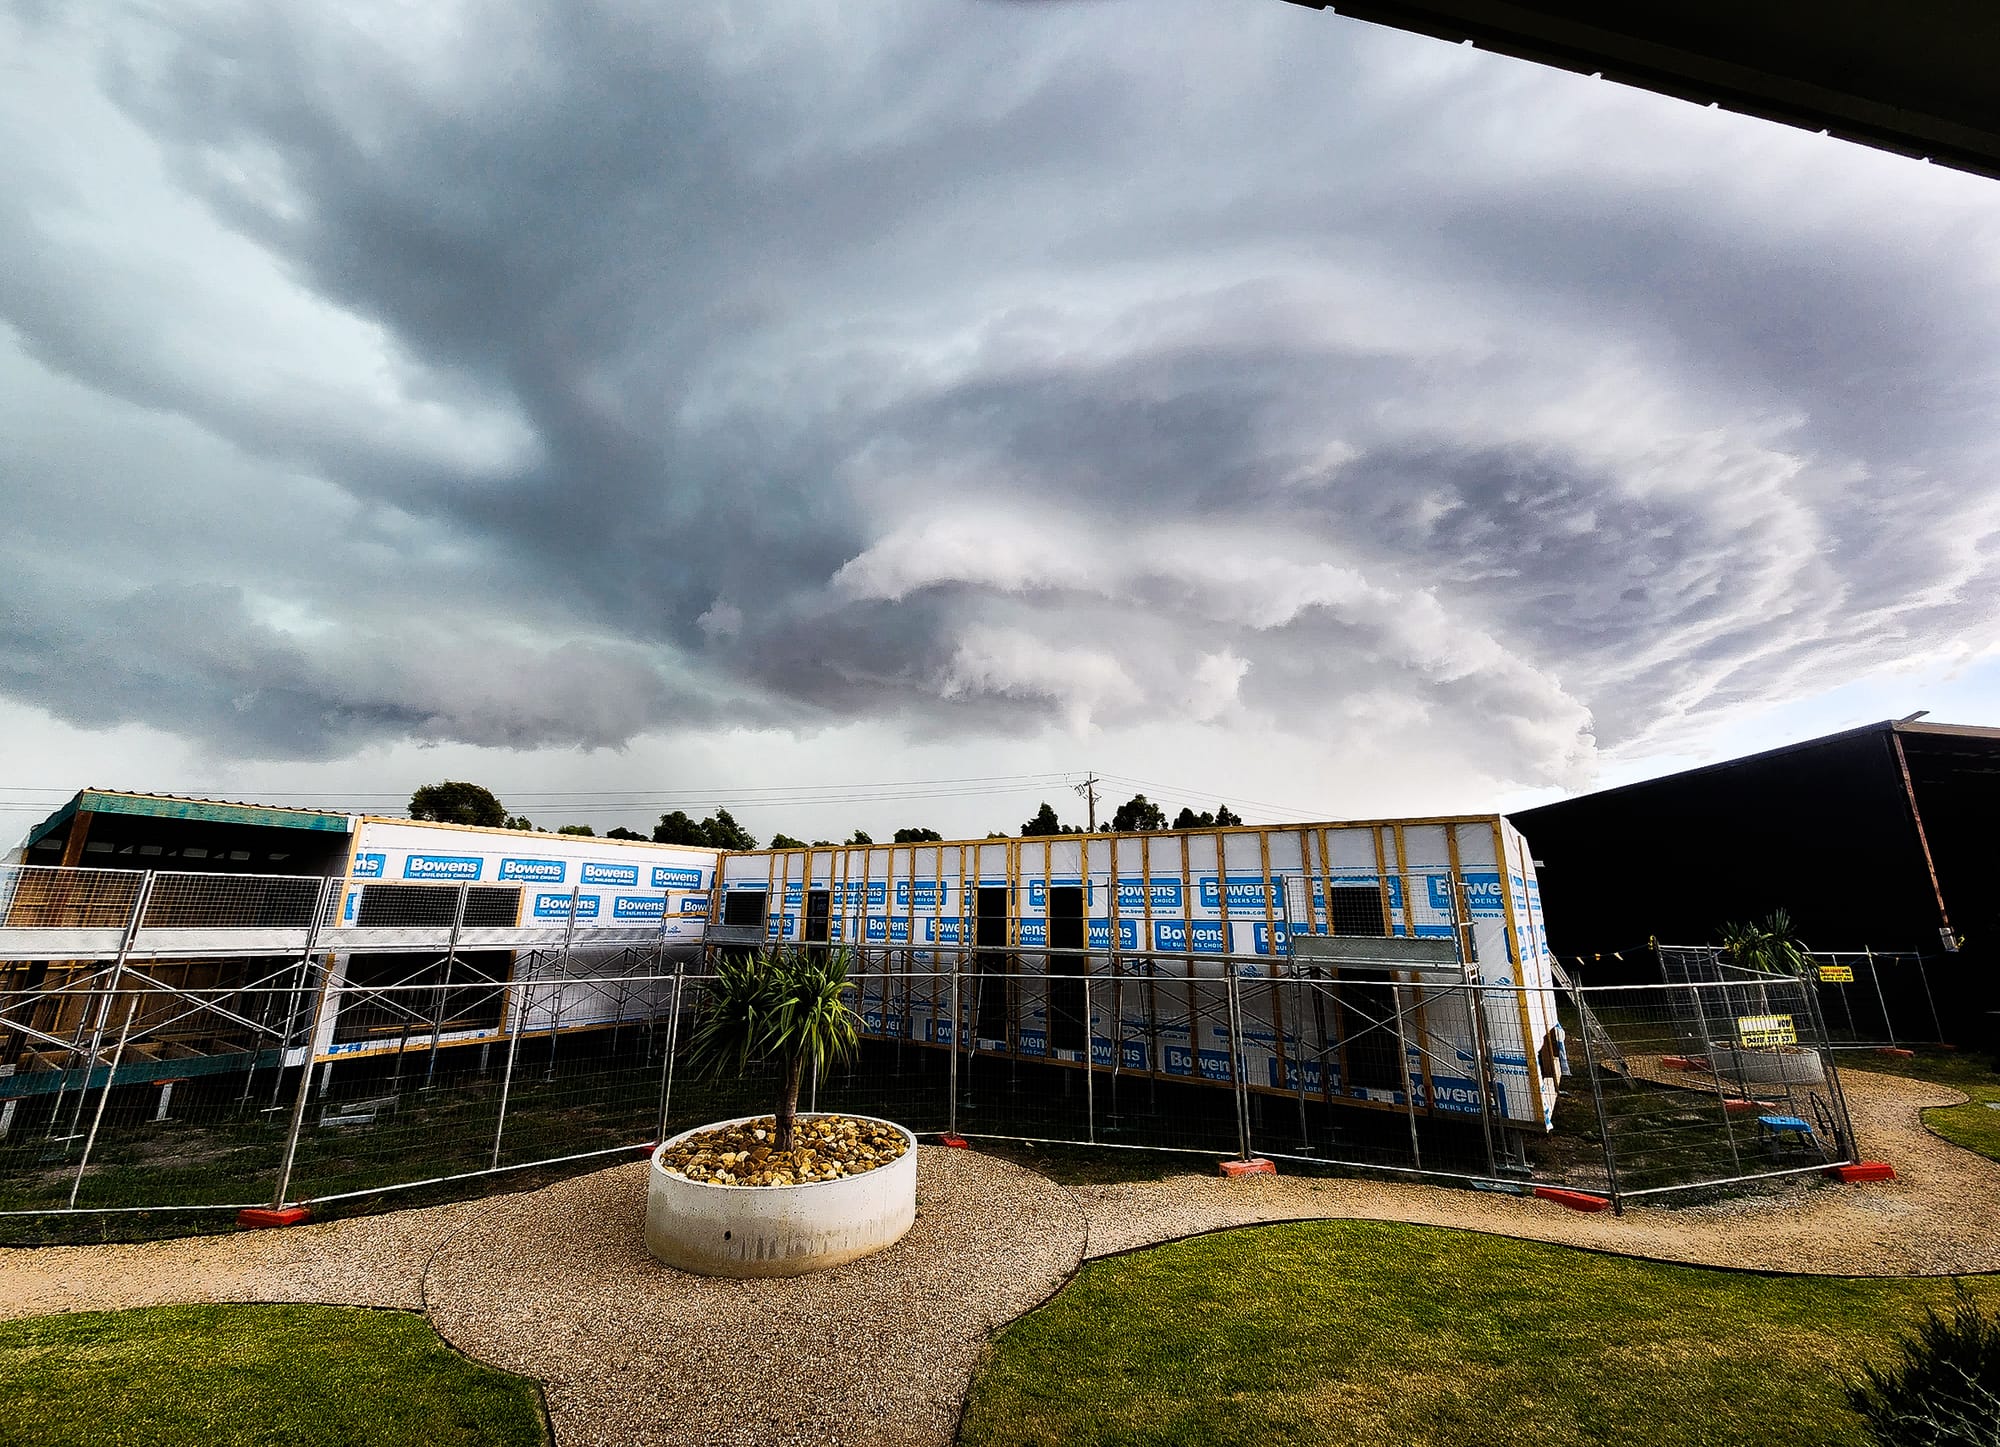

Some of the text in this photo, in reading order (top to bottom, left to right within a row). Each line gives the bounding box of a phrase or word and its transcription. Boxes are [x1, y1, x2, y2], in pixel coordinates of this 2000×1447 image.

[410, 858, 478, 873] Bowens
[504, 861, 562, 875] Bowens
[585, 865, 635, 879] Bowens
[655, 869, 699, 882] Bowens
[539, 897, 596, 909] Bowns
[618, 899, 665, 910] Bowens
[930, 920, 969, 932] Bowen
[1092, 1044, 1141, 1060] owns
[1170, 1051, 1242, 1072] Bowen
